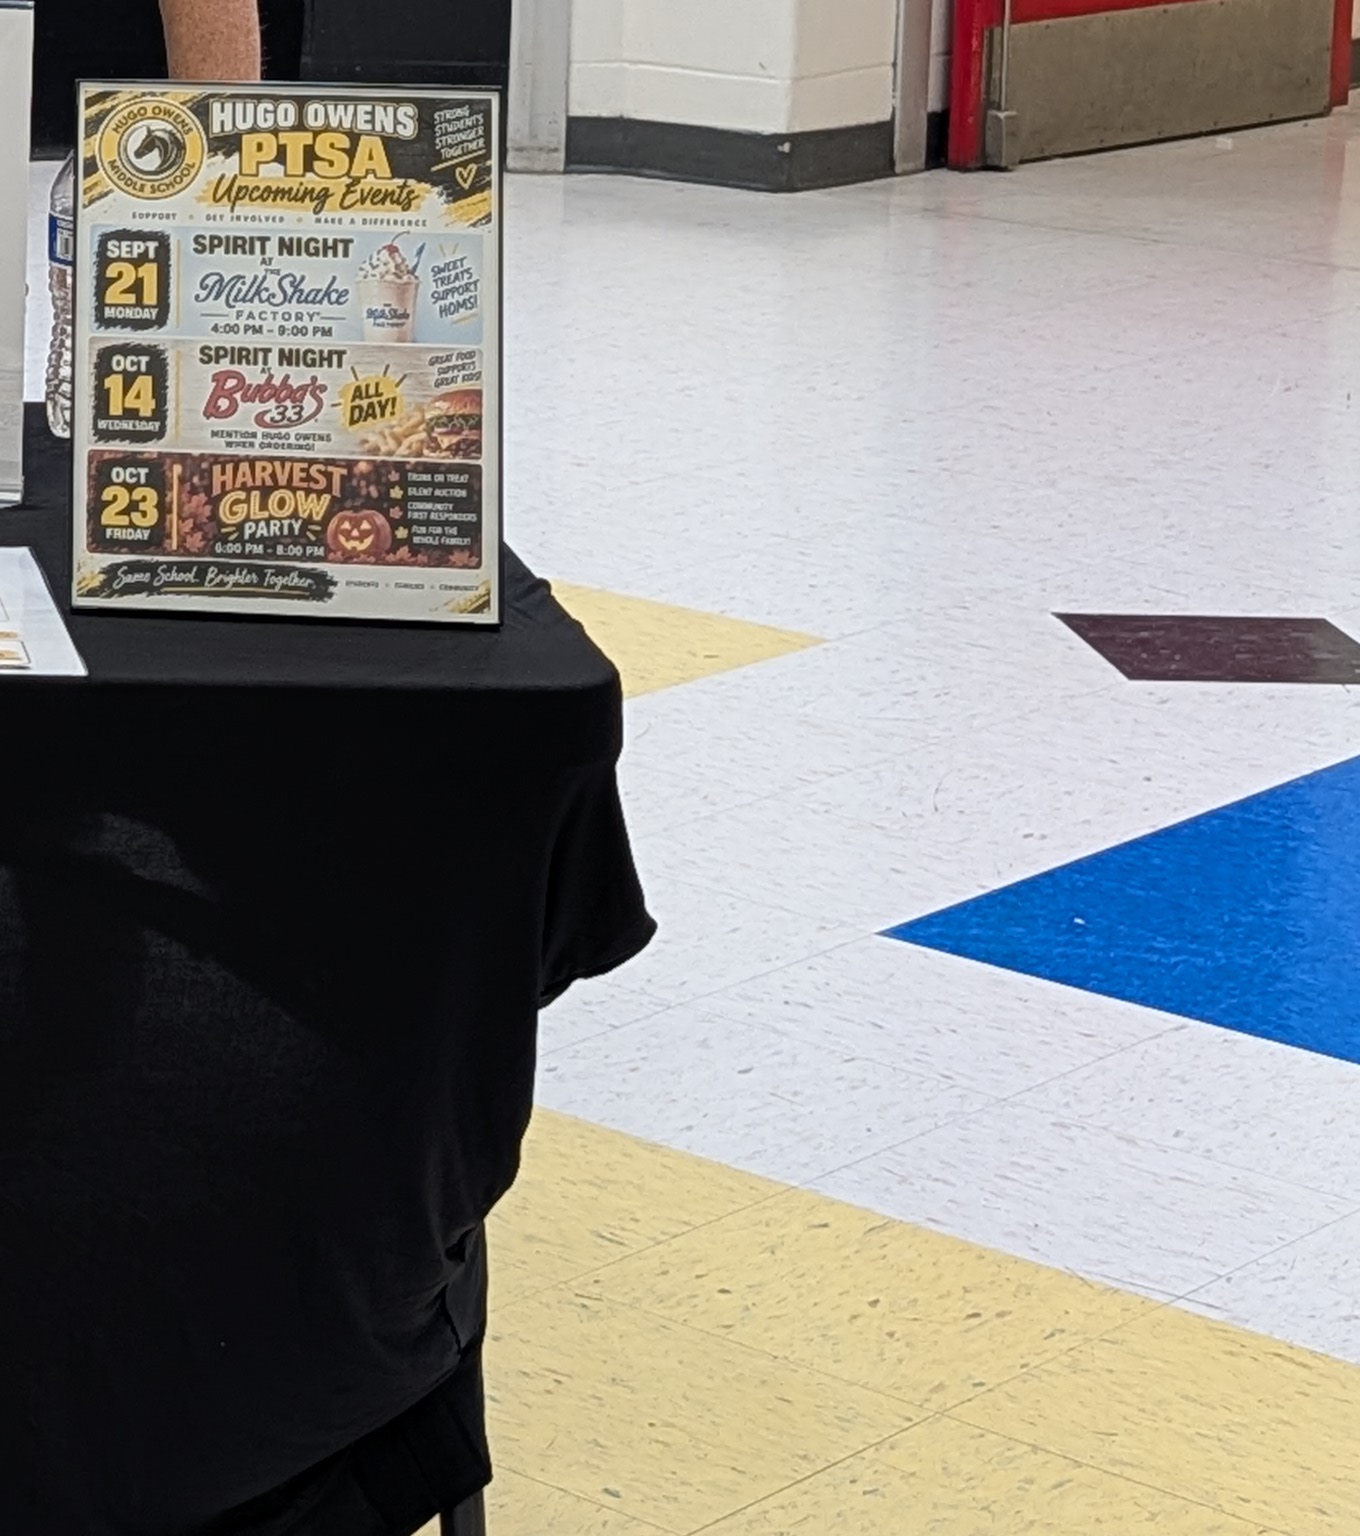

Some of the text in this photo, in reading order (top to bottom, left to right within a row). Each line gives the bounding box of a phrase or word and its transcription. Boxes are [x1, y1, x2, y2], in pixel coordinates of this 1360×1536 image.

[112, 106, 194, 135] HUGO OWENS
[211, 101, 417, 139] HUGO OWENS
[240, 131, 392, 179] PTSA
[441, 137, 486, 160] TOGETHER
[108, 159, 196, 194] MIDDLE SCHOOL
[212, 172, 419, 215] Upcoming Events
[132, 212, 177, 220] SUPPORT
[205, 214, 225, 222] GET
[106, 240, 159, 259] SEPT
[192, 234, 354, 258] SPIRIT NIGHT
[260, 257, 274, 266] AT
[431, 256, 467, 278] SWEET
[104, 261, 158, 305] 21
[432, 267, 473, 289] TREATS
[194, 272, 349, 308] MilkShake
[431, 279, 480, 304] SUPPORT
[104, 306, 159, 320] MONDAY
[235, 310, 318, 322] FACTORY
[438, 295, 478, 319] HOMS!
[211, 323, 240, 335] 4:00
[243, 324, 264, 335] PM
[312, 326, 333, 337] PM
[111, 354, 150, 372] OCT
[198, 345, 347, 368] SPIRIT NIGHT
[103, 374, 156, 417] 14
[203, 369, 328, 421] Bubba's
[351, 380, 385, 403] ALL
[270, 405, 305, 424] 33
[349, 397, 397, 425] DAY!
[97, 419, 161, 432] WEDNESDAY
[111, 467, 149, 484] OCT
[211, 461, 348, 498] HARVEST
[100, 485, 159, 527] 23
[219, 489, 331, 524] GLOW
[106, 528, 151, 541] FRIDAY
[244, 518, 303, 539] PARTY
[245, 543, 264, 554] PM
[306, 546, 325, 556] PM
[204, 567, 258, 593] Brighter
